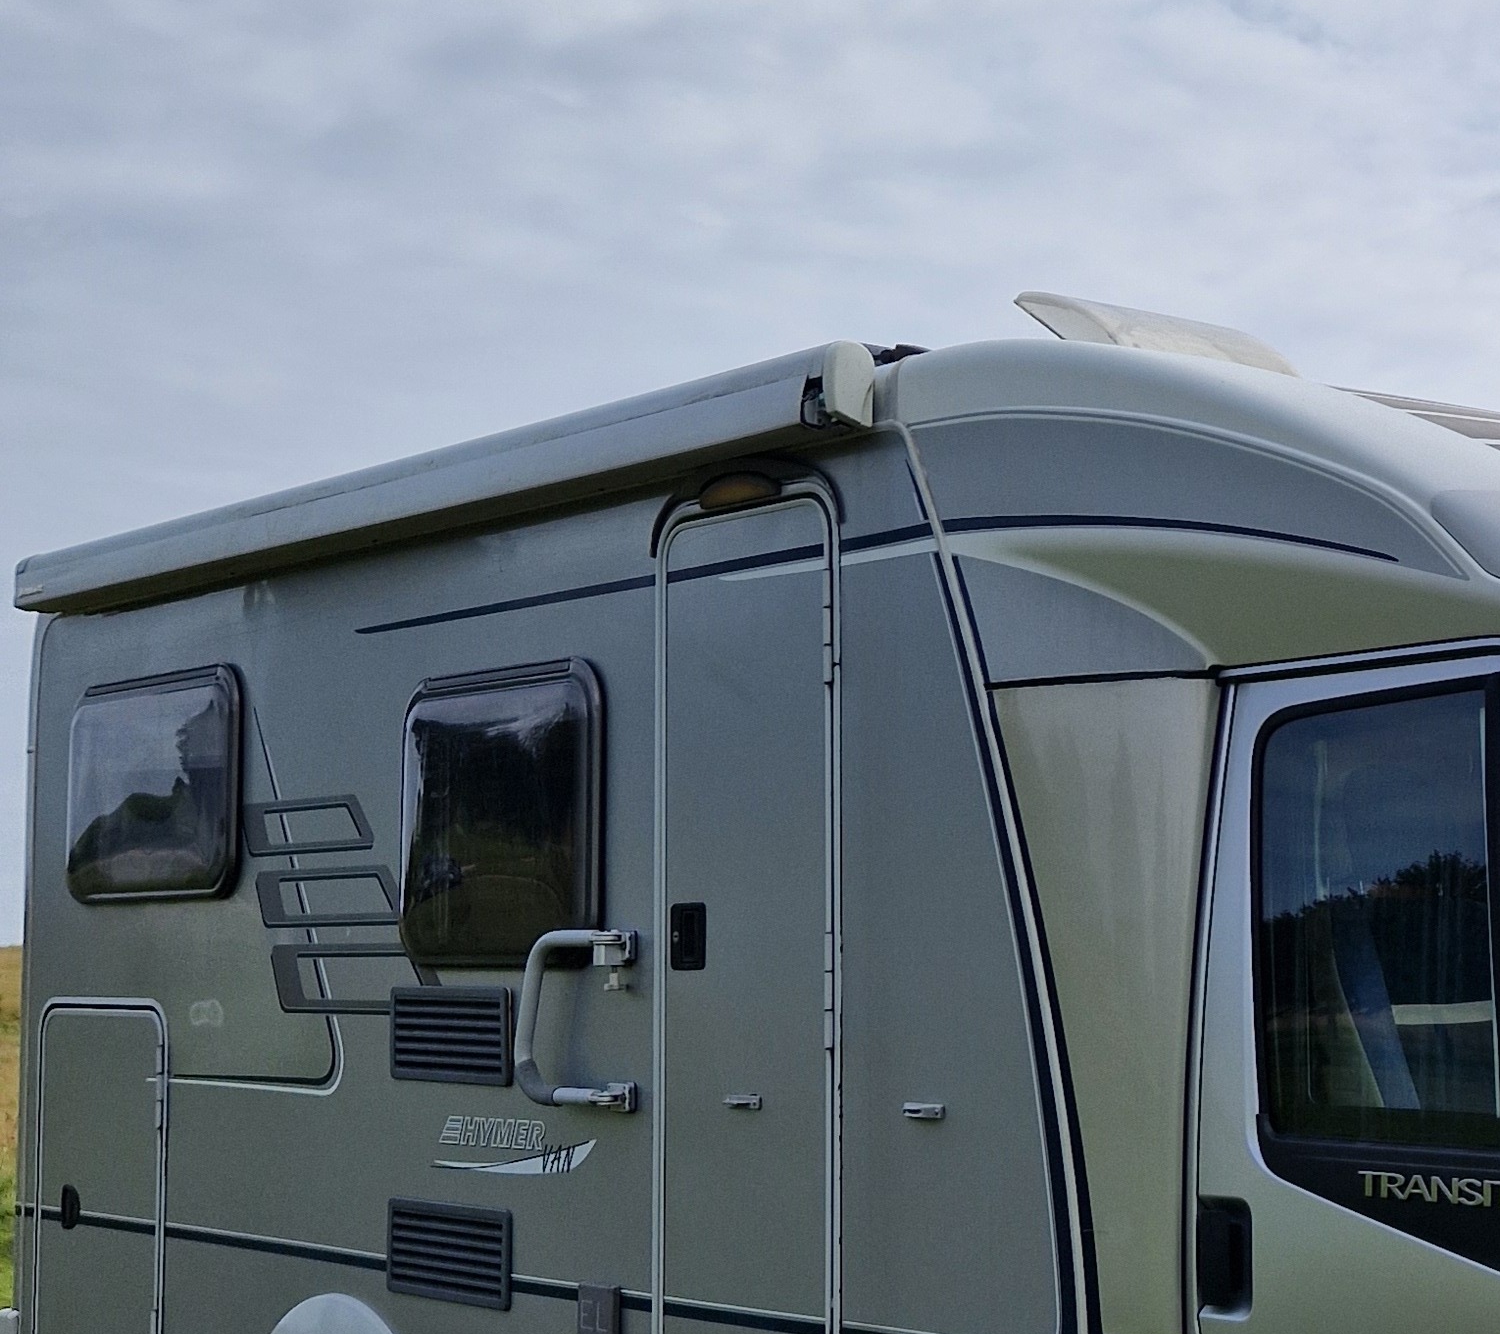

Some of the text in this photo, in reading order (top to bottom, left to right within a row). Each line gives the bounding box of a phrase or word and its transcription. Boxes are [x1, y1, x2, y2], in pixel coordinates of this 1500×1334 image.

[460, 1116, 546, 1151] HYMER
[542, 1144, 576, 1174] VAN
[580, 1299, 608, 1332] EL
